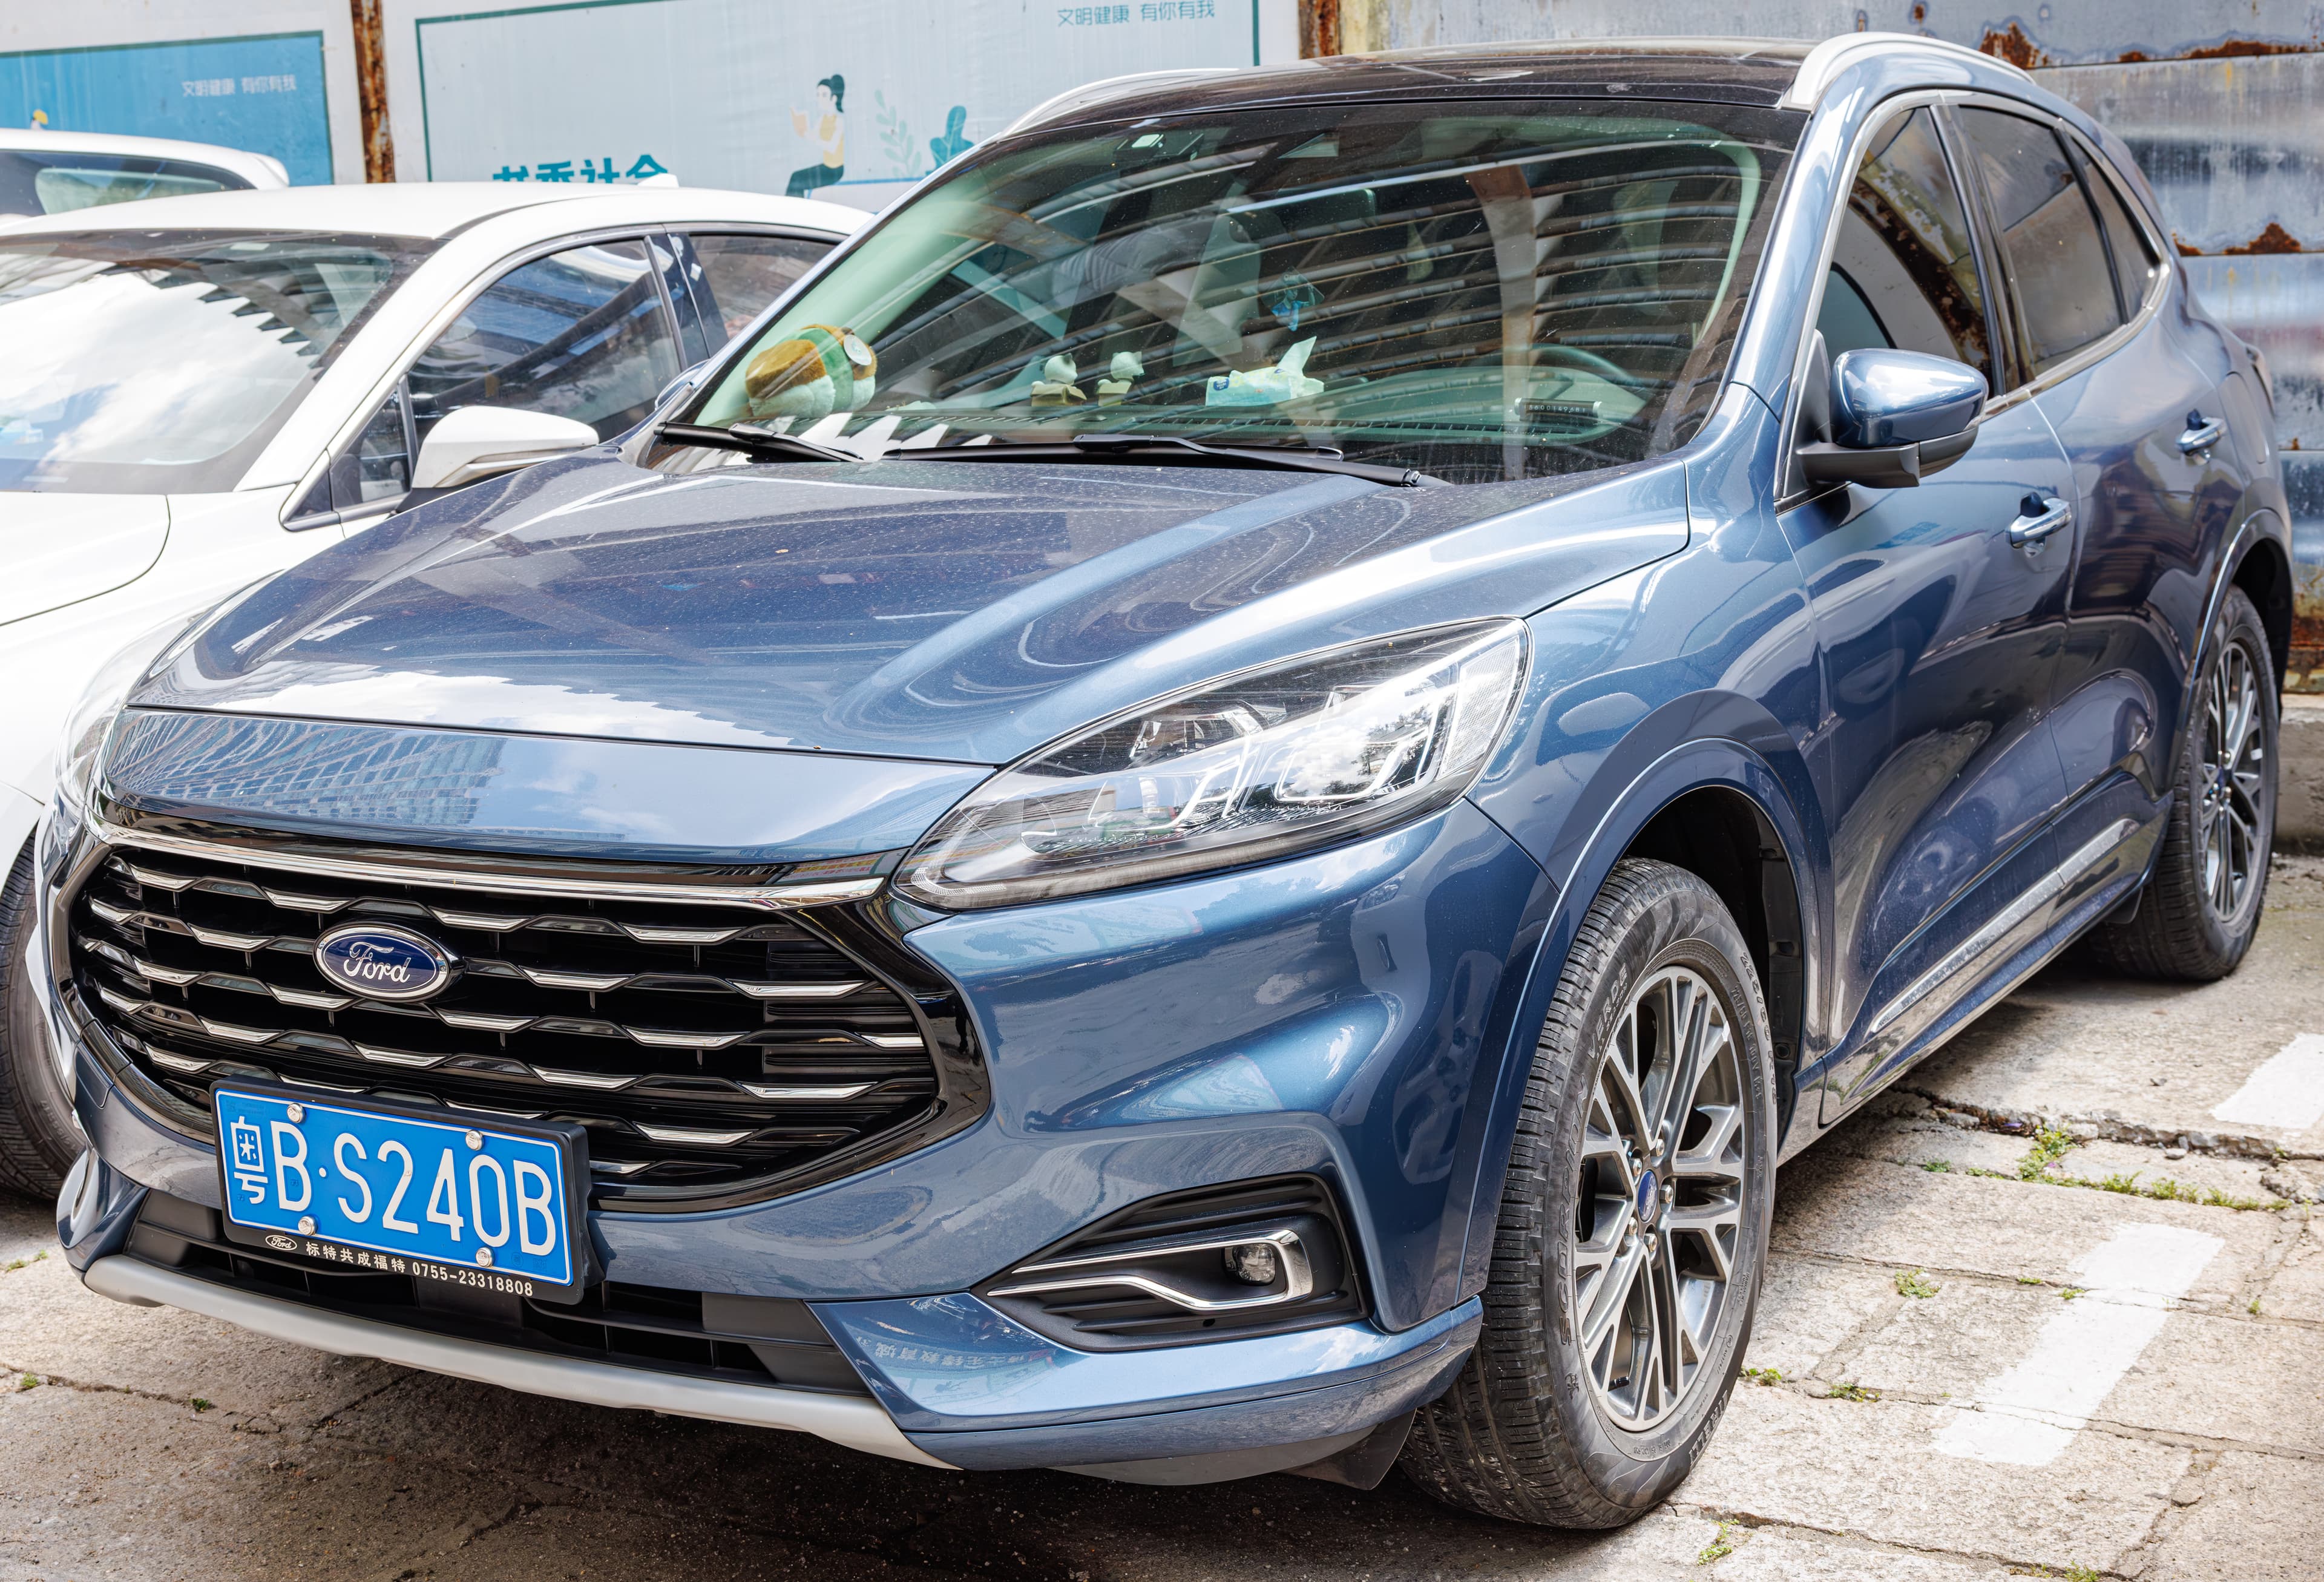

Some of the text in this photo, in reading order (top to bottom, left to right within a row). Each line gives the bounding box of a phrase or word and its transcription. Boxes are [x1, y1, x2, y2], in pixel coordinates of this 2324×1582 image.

[1057, 0, 1215, 27] 文明健康 有你有我
[343, 941, 412, 983] Ford
[1587, 962, 1627, 1059] VERDE
[230, 1115, 556, 1256] 粤B·S240B
[1557, 1072, 1589, 1346] SCORPION
[412, 1261, 533, 1296] 0755-23318808
